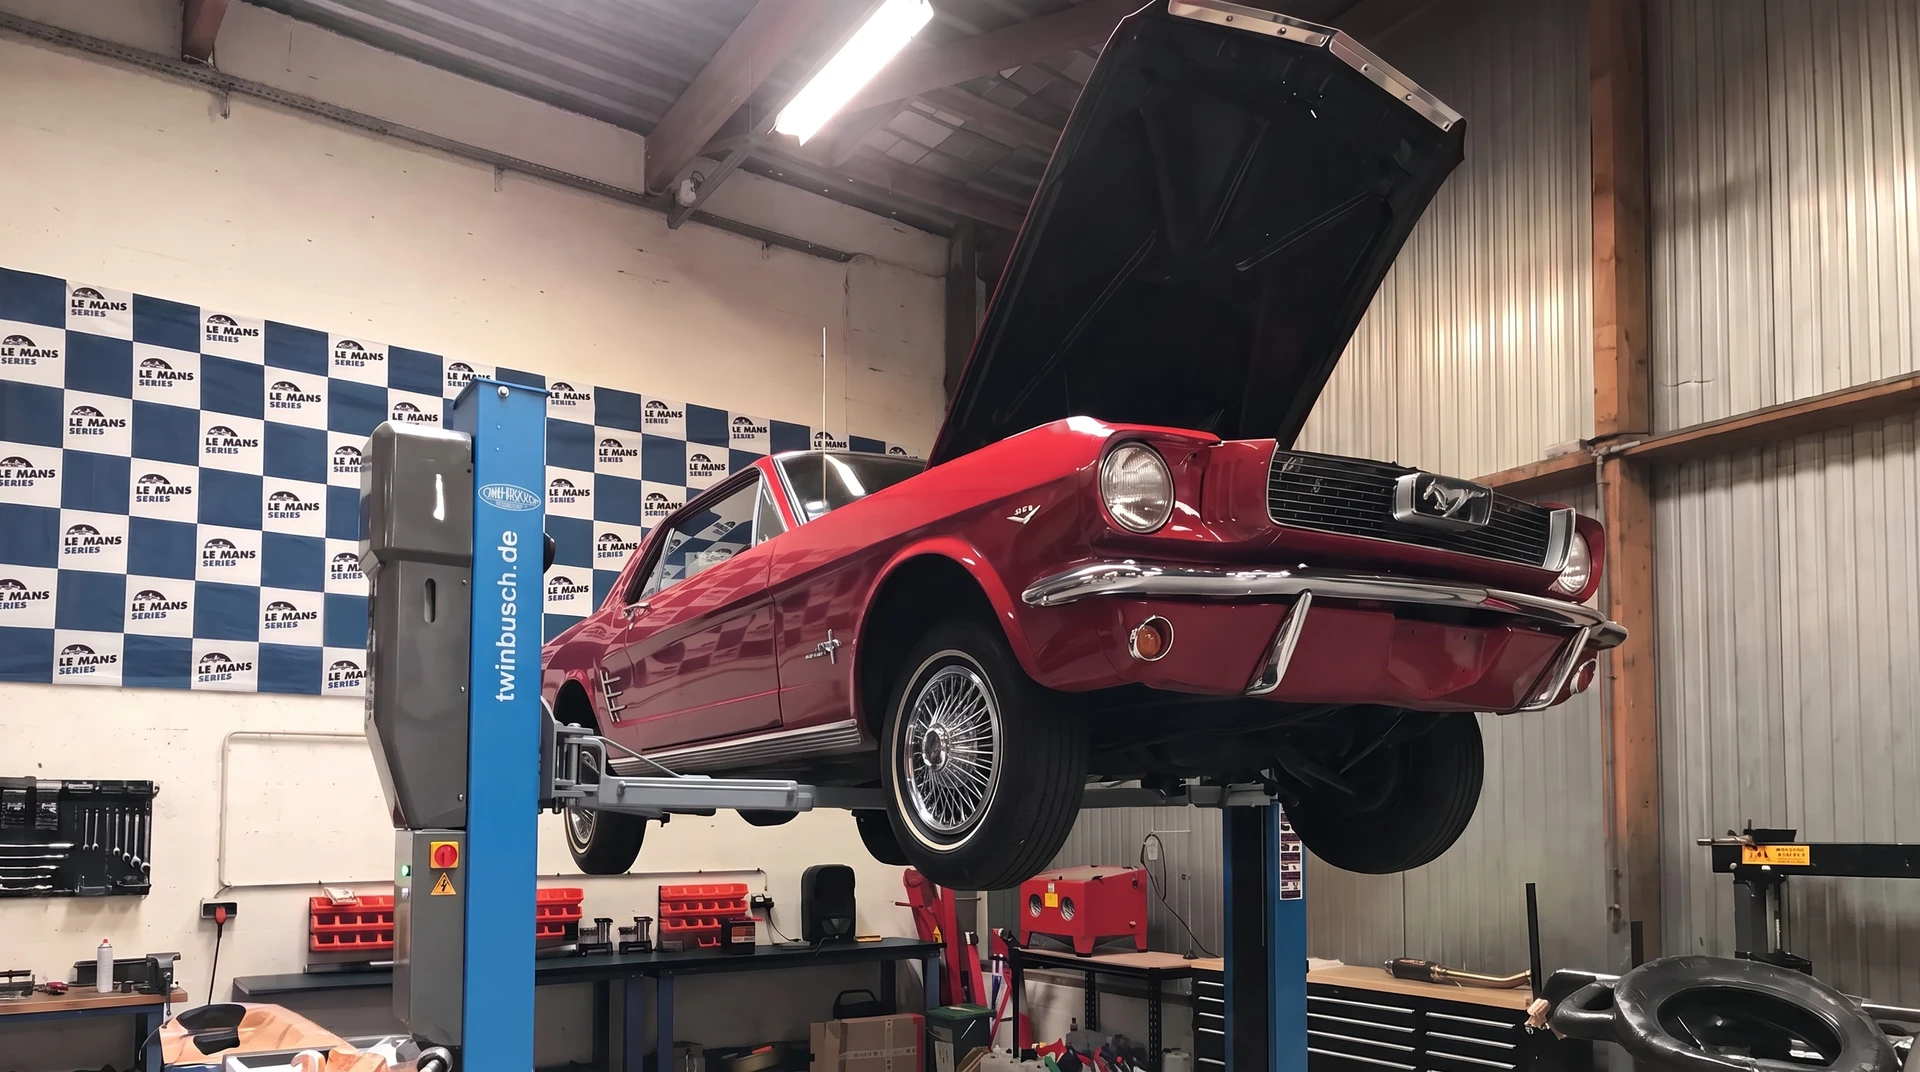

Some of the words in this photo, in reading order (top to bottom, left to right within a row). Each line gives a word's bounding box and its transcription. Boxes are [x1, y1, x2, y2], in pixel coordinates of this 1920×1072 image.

[71, 299, 84, 308] LE
[89, 301, 127, 311] MANS
[71, 309, 106, 317] SERIES
[206, 325, 218, 334] LE
[223, 327, 259, 336] MANS
[206, 334, 239, 343] SERIES
[1, 347, 16, 356] LE
[20, 348, 58, 358] MANS
[335, 350, 346, 358] LE
[351, 352, 384, 361] MANS
[1, 357, 36, 365] SERIES
[335, 359, 365, 367] SERIES
[139, 370, 152, 379] LE
[157, 371, 194, 380] MANS
[447, 372, 458, 380] LE
[139, 379, 173, 387] SERIES
[270, 392, 282, 401] LE
[286, 393, 321, 402] MANS
[563, 392, 591, 400] MANS
[392, 412, 404, 421] LE
[407, 413, 438, 422] MANS
[645, 409, 654, 417] LE
[657, 410, 683, 419] MANS
[69, 417, 83, 427] LE
[88, 418, 126, 427] MANS
[69, 427, 104, 435] SERIES
[744, 426, 767, 434] MANS
[206, 437, 218, 447] LE
[223, 438, 258, 447] MANS
[814, 440, 822, 448] LE
[825, 441, 847, 449] MANS
[599, 448, 609, 457] LE
[612, 449, 638, 457] MANS
[333, 456, 346, 465] LE
[689, 463, 698, 471] LE
[701, 463, 726, 471] MANS
[16, 469, 55, 478] MANS
[136, 486, 150, 494] LE
[154, 486, 191, 495] MANS
[549, 488, 559, 496] LE
[563, 488, 590, 497] MANS
[549, 496, 576, 504] SERIES
[268, 503, 280, 511] LE
[284, 502, 319, 511] MANS
[645, 502, 654, 510] LE
[268, 511, 300, 519] SERIES
[65, 537, 78, 546] LE
[83, 536, 122, 545] MANS
[65, 546, 100, 554] SERIES
[598, 543, 607, 551] LE
[611, 543, 638, 551] MANS
[202, 551, 216, 559] LE
[220, 550, 256, 559] MANS
[598, 551, 624, 559] SERIES
[202, 559, 236, 567] SERIES
[331, 564, 344, 572] LE
[331, 572, 362, 580] SERIES
[548, 586, 558, 594] LE
[561, 585, 589, 594] MANS
[9, 591, 50, 601] MANS
[548, 594, 574, 602] SERIES
[132, 603, 146, 611] LE
[150, 601, 187, 611] MANS
[132, 611, 166, 620] SERIES
[265, 613, 277, 621] LE
[281, 611, 317, 621] MANS
[495, 530, 518, 702] twinbusch.de
[265, 621, 298, 629] SERIES
[59, 657, 74, 666] LE
[78, 655, 117, 665] MANS
[59, 666, 95, 675] SERIES
[198, 665, 211, 674] LE
[216, 662, 252, 673] MANS
[198, 673, 232, 682] SERIES
[328, 672, 341, 681] LE
[328, 680, 360, 688] SERIES
